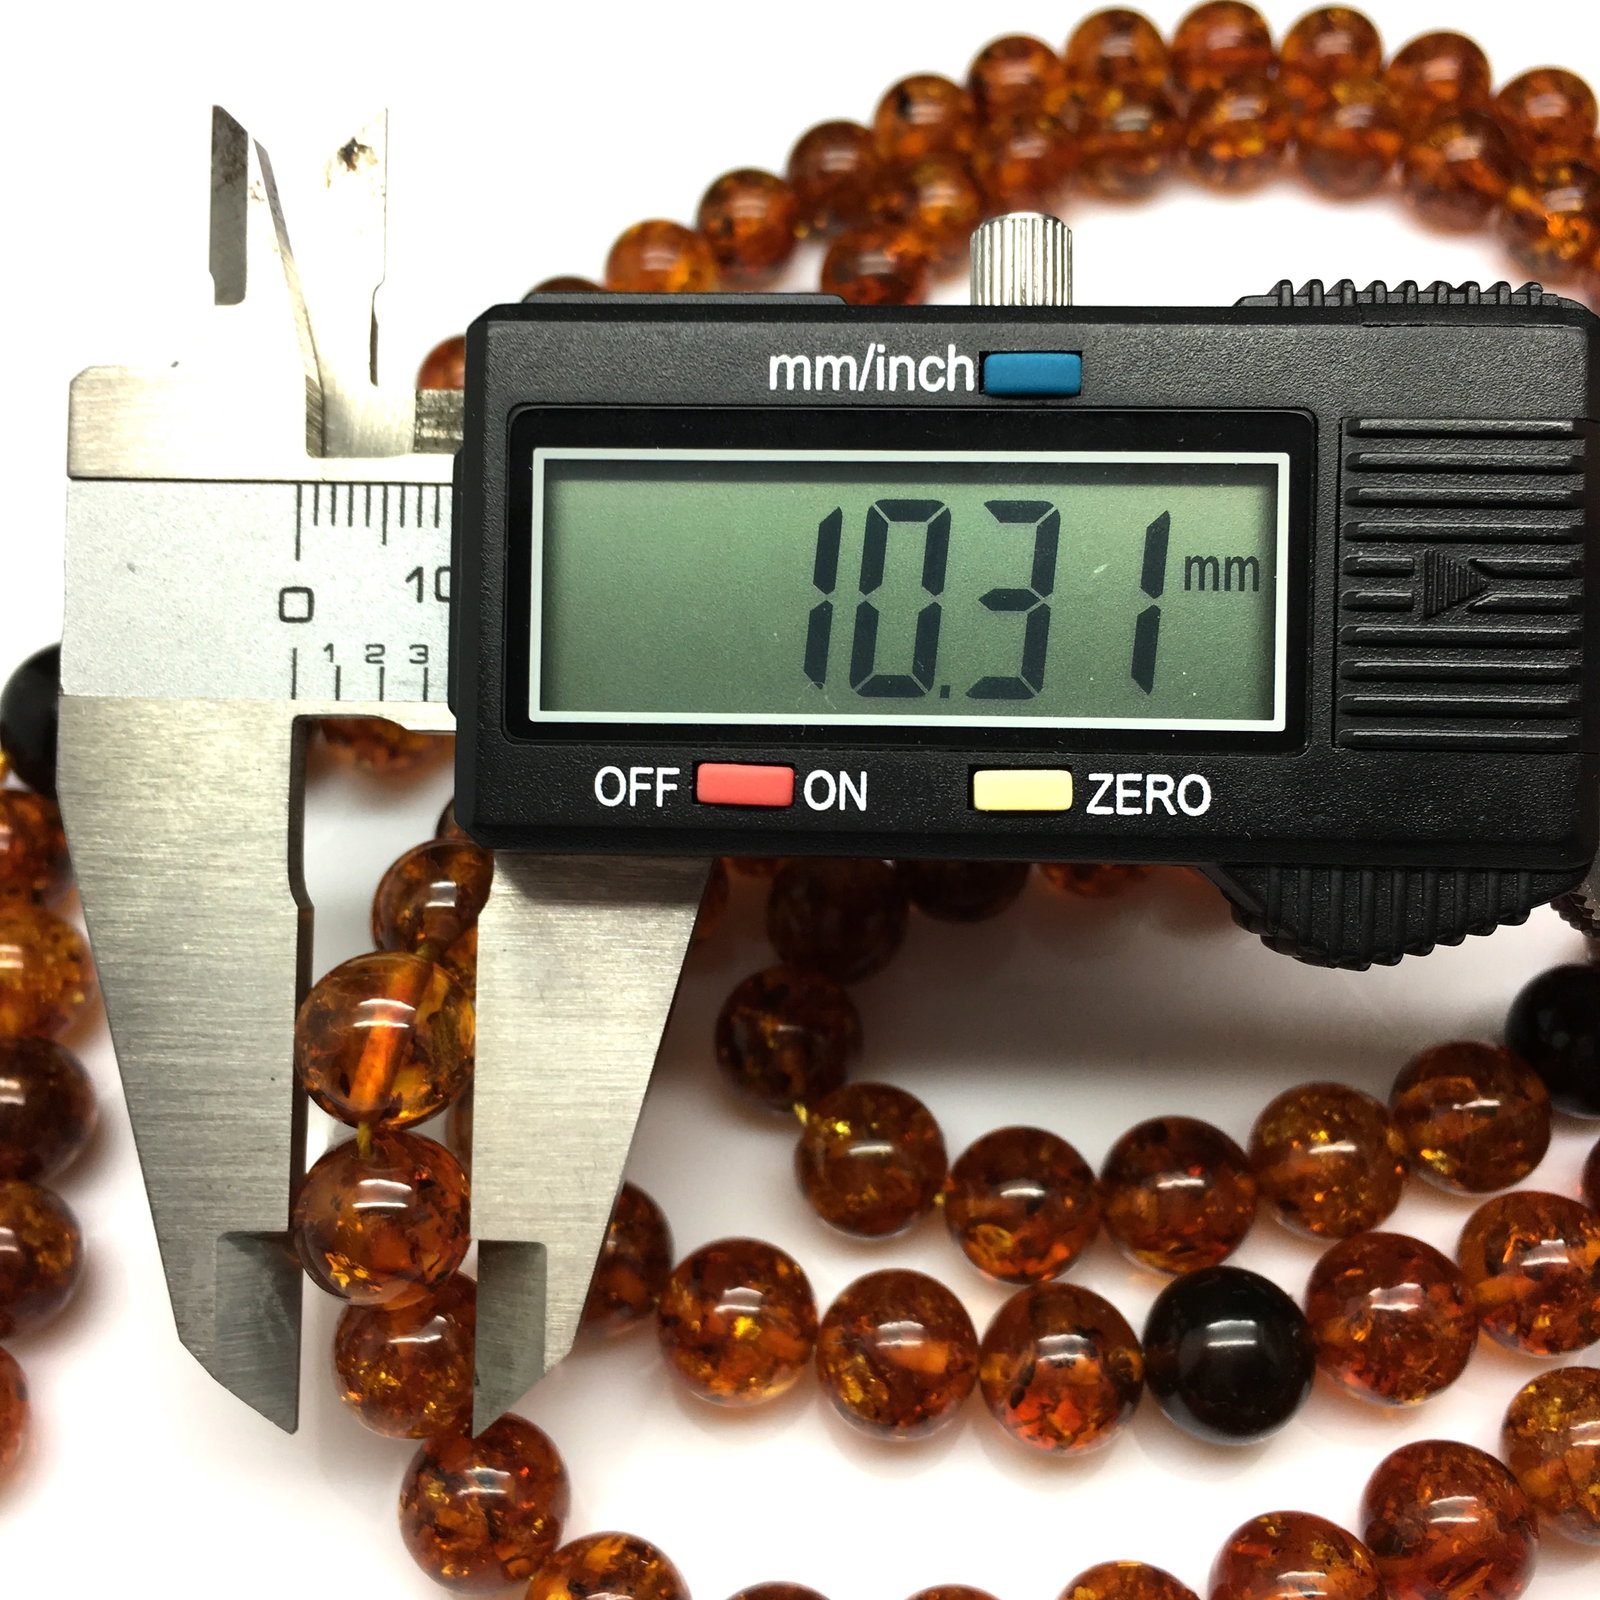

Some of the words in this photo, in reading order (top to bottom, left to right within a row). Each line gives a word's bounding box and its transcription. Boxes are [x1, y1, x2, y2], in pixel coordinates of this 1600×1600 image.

[768, 343, 976, 393] mm/inch
[278, 586, 315, 624] 0
[803, 499, 1172, 700] 10.31
[1184, 554, 1261, 592] mm
[323, 643, 335, 664] 1
[365, 643, 386, 665] 2
[409, 643, 430, 665] 3
[593, 764, 681, 809] OFF
[803, 769, 868, 813] ON
[1086, 772, 1213, 818] ZERO
